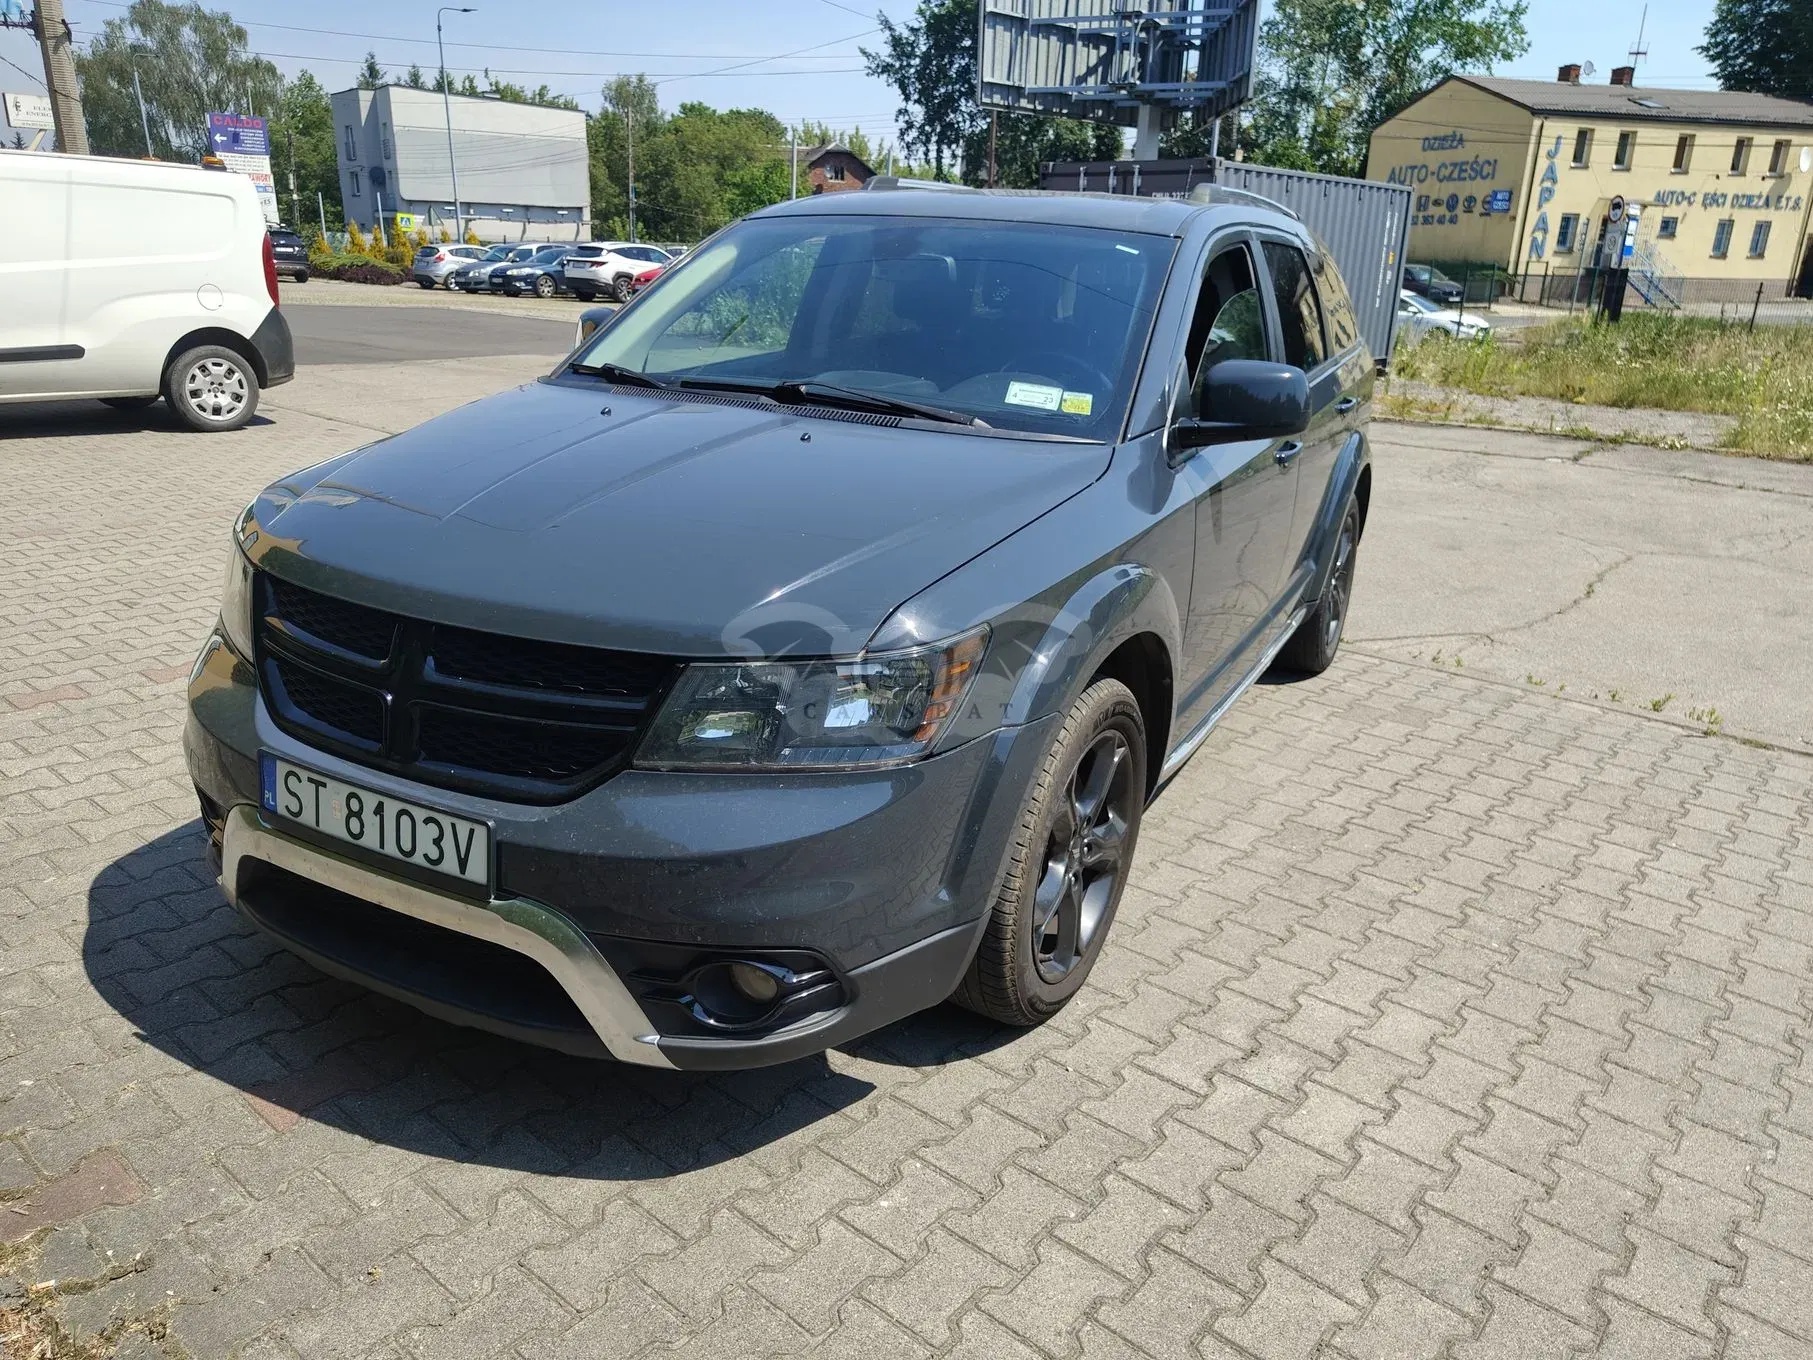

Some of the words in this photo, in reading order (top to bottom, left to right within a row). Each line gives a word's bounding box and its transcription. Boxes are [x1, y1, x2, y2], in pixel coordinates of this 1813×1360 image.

[214, 115, 262, 128] CALDO
[1528, 135, 1563, 259] JAPAN
[1043, 396, 1054, 404] 23
[264, 790, 275, 805] PL
[284, 770, 327, 828] ST
[345, 791, 475, 876] 8103V
